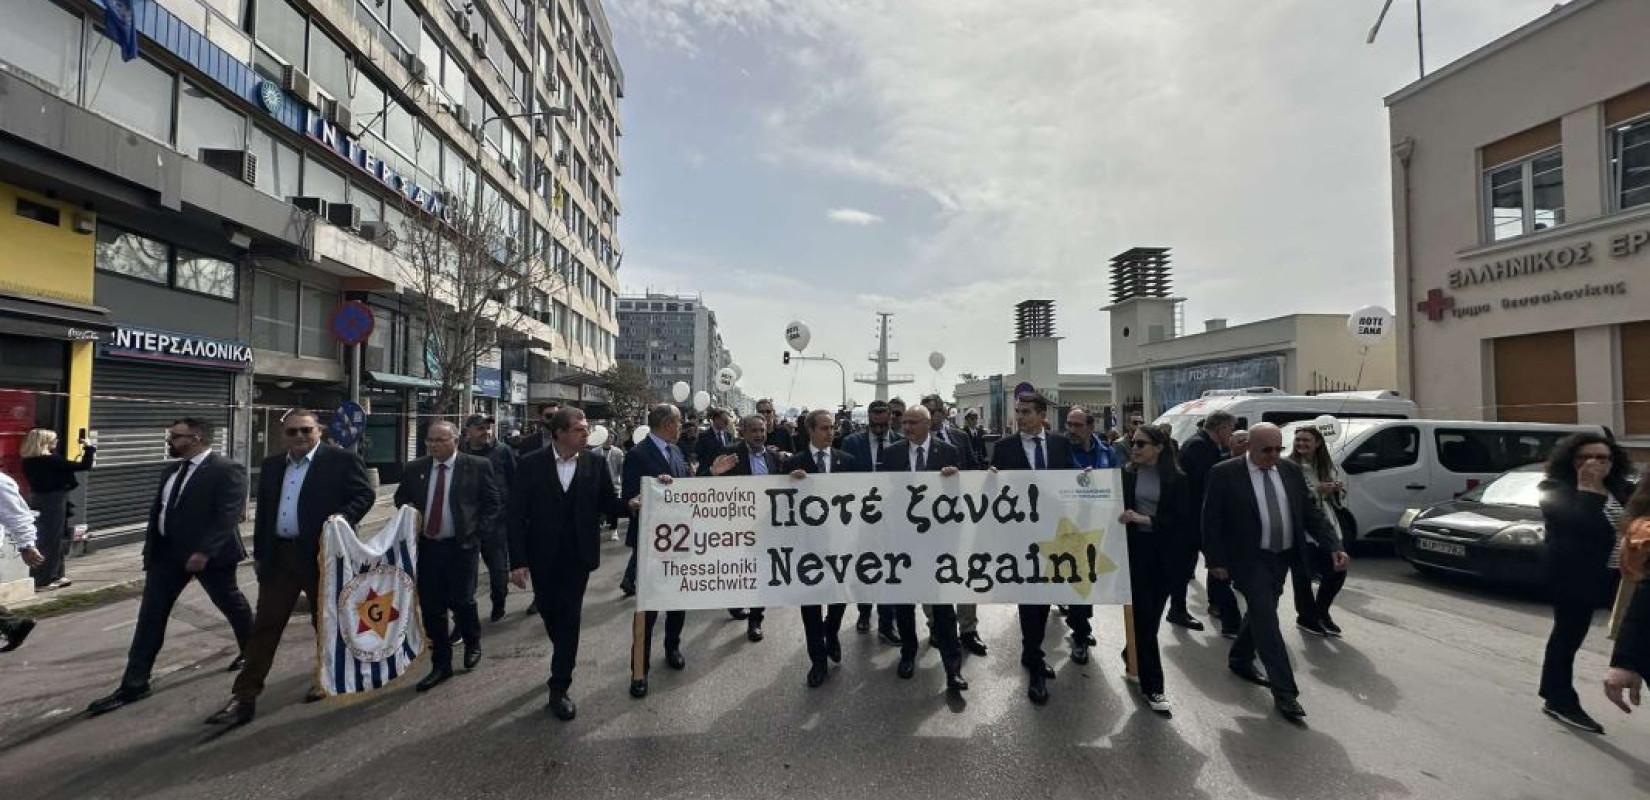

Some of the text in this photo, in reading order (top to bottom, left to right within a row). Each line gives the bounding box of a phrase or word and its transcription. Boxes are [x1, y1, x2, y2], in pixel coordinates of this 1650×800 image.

[1448, 241, 1593, 289] ΕΛΛΗΝΙΚΟΣ
[690, 502, 756, 521] Άουσβιτς
[765, 483, 1041, 534] Ποτέ ξανά!
[654, 523, 757, 556] 82 years
[662, 558, 757, 577] Thessaloniki
[767, 543, 1098, 593] Never again!
[680, 575, 758, 592] Auschwitz
[367, 603, 383, 622] G
